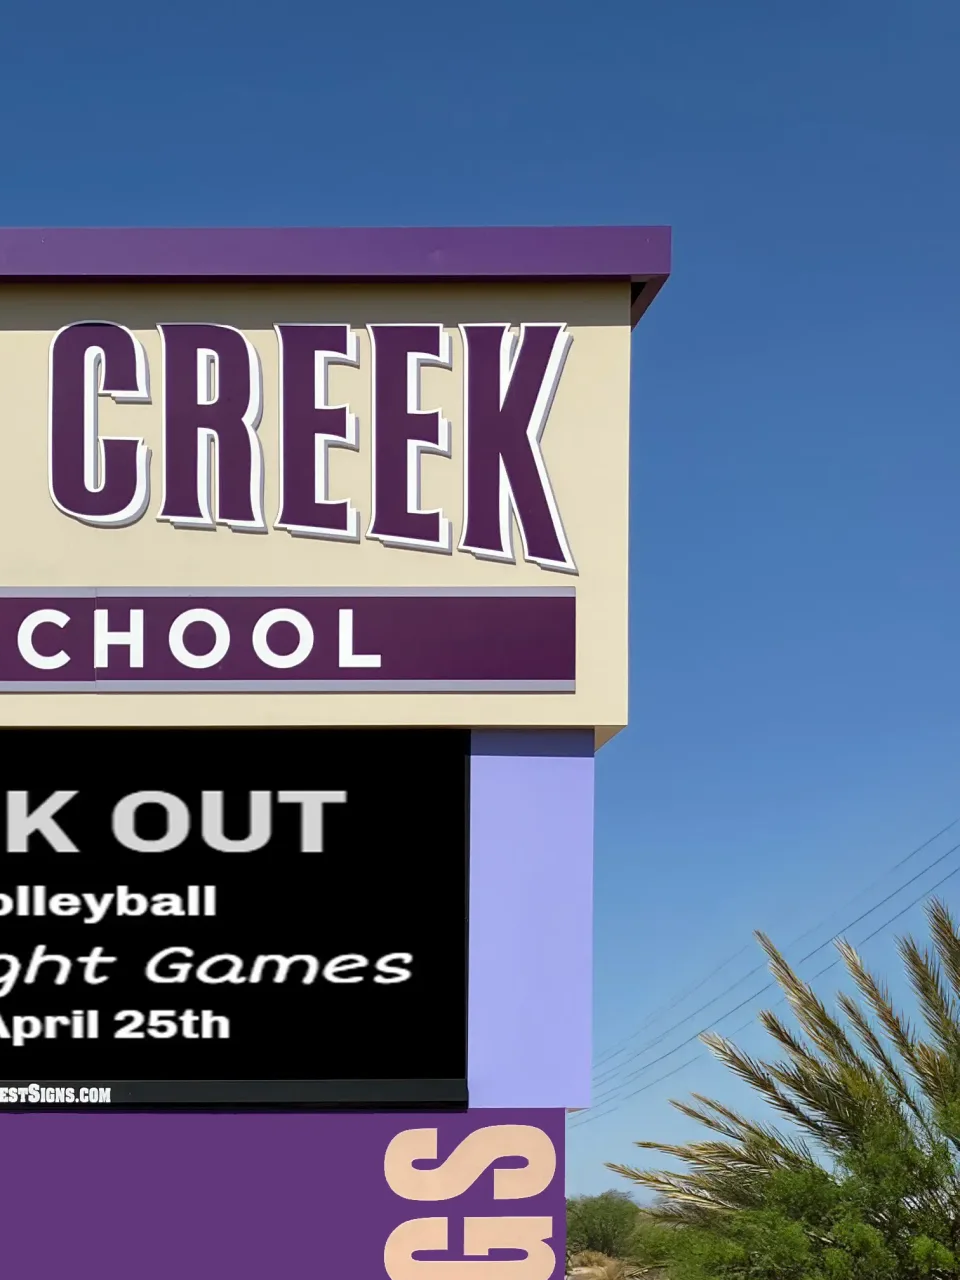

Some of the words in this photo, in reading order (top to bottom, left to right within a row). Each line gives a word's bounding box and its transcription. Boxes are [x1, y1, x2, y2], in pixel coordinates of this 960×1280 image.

[48, 320, 579, 576] CREEK
[111, 790, 348, 853] OUT
[145, 946, 414, 985] Games
[113, 1009, 230, 1039] 25th
